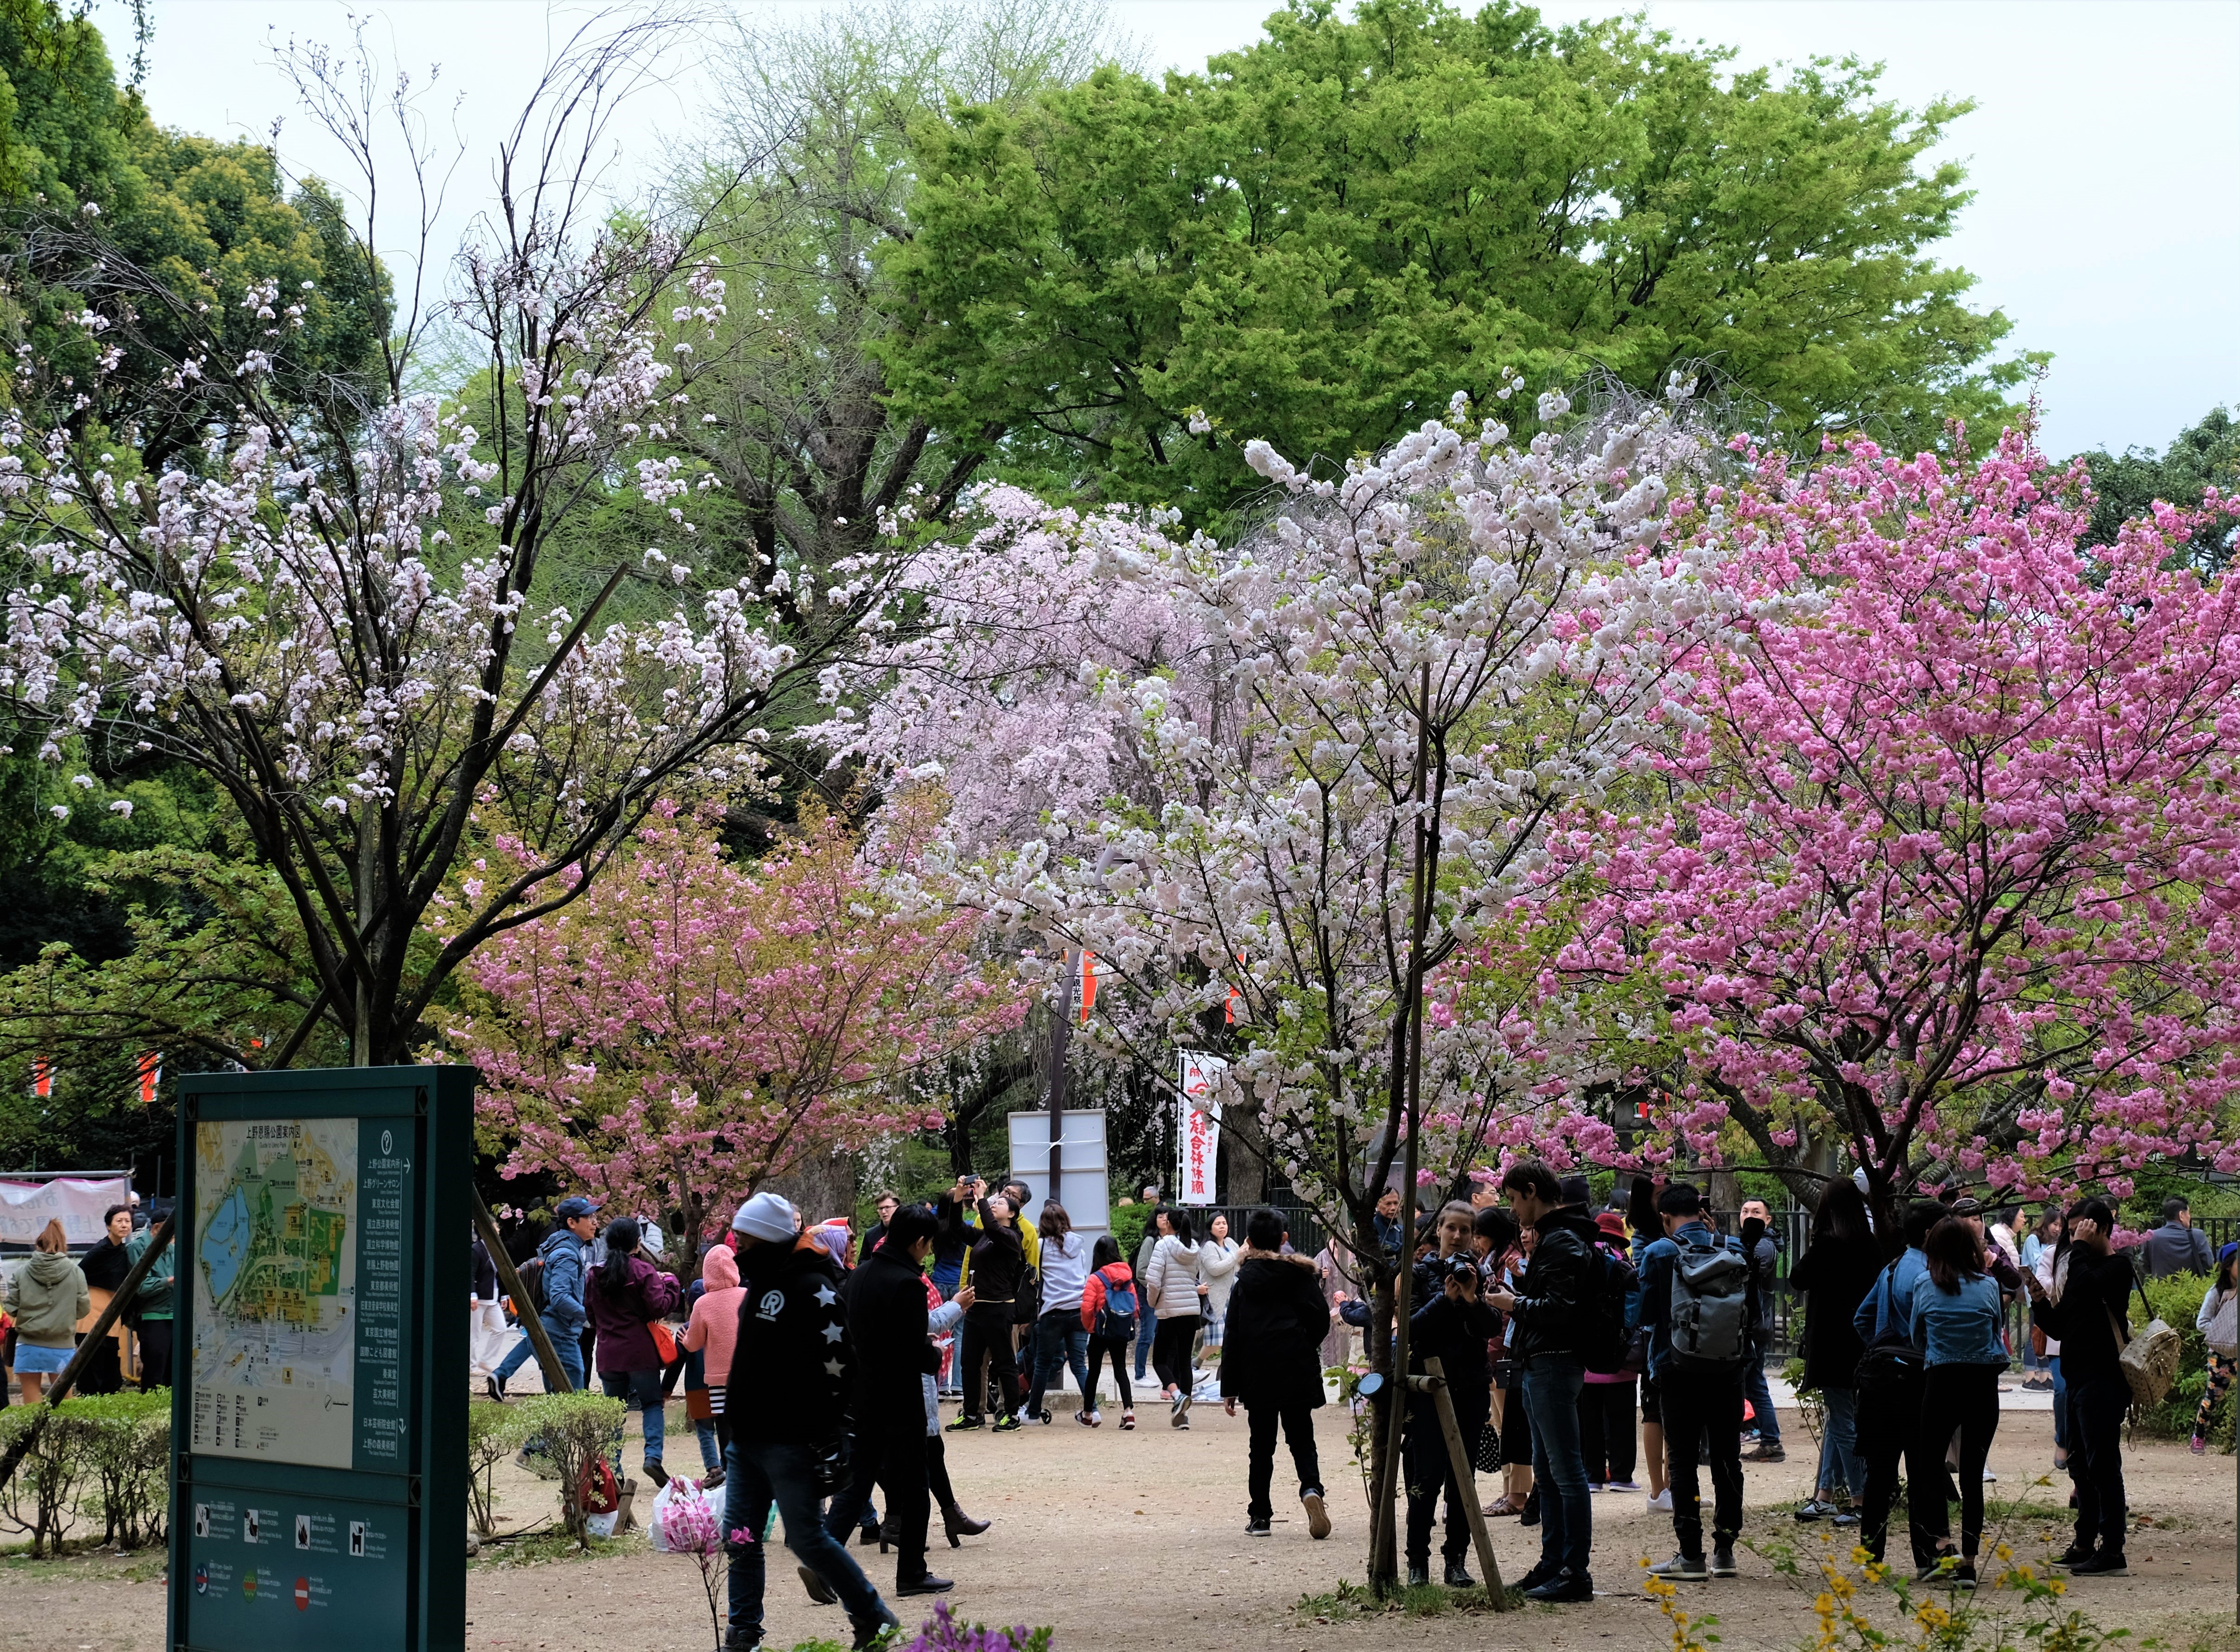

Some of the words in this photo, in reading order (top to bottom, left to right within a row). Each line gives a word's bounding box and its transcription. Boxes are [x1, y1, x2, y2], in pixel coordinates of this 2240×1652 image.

[246, 1125, 301, 1139] 上野恩賜公園案内図
[368, 1159, 400, 1169] 上野公園案内所
[363, 1179, 400, 1189] 上野グリーンサロン
[371, 1199, 400, 1209] 東京文化会館
[366, 1219, 399, 1230] 国立西洋美術館
[366, 1239, 399, 1250] 国立科学博物館
[366, 1260, 399, 1270] 恩賜上野動物園
[371, 1281, 398, 1291] 東京都美術館
[365, 1327, 397, 1339] 東京国立博物館
[383, 1369, 397, 1379] 奏楽堂
[373, 1388, 397, 1400] 芸大美術館
[364, 1418, 396, 1430] 日本芸術院会館
[363, 1438, 396, 1451] 上野の森美術館
